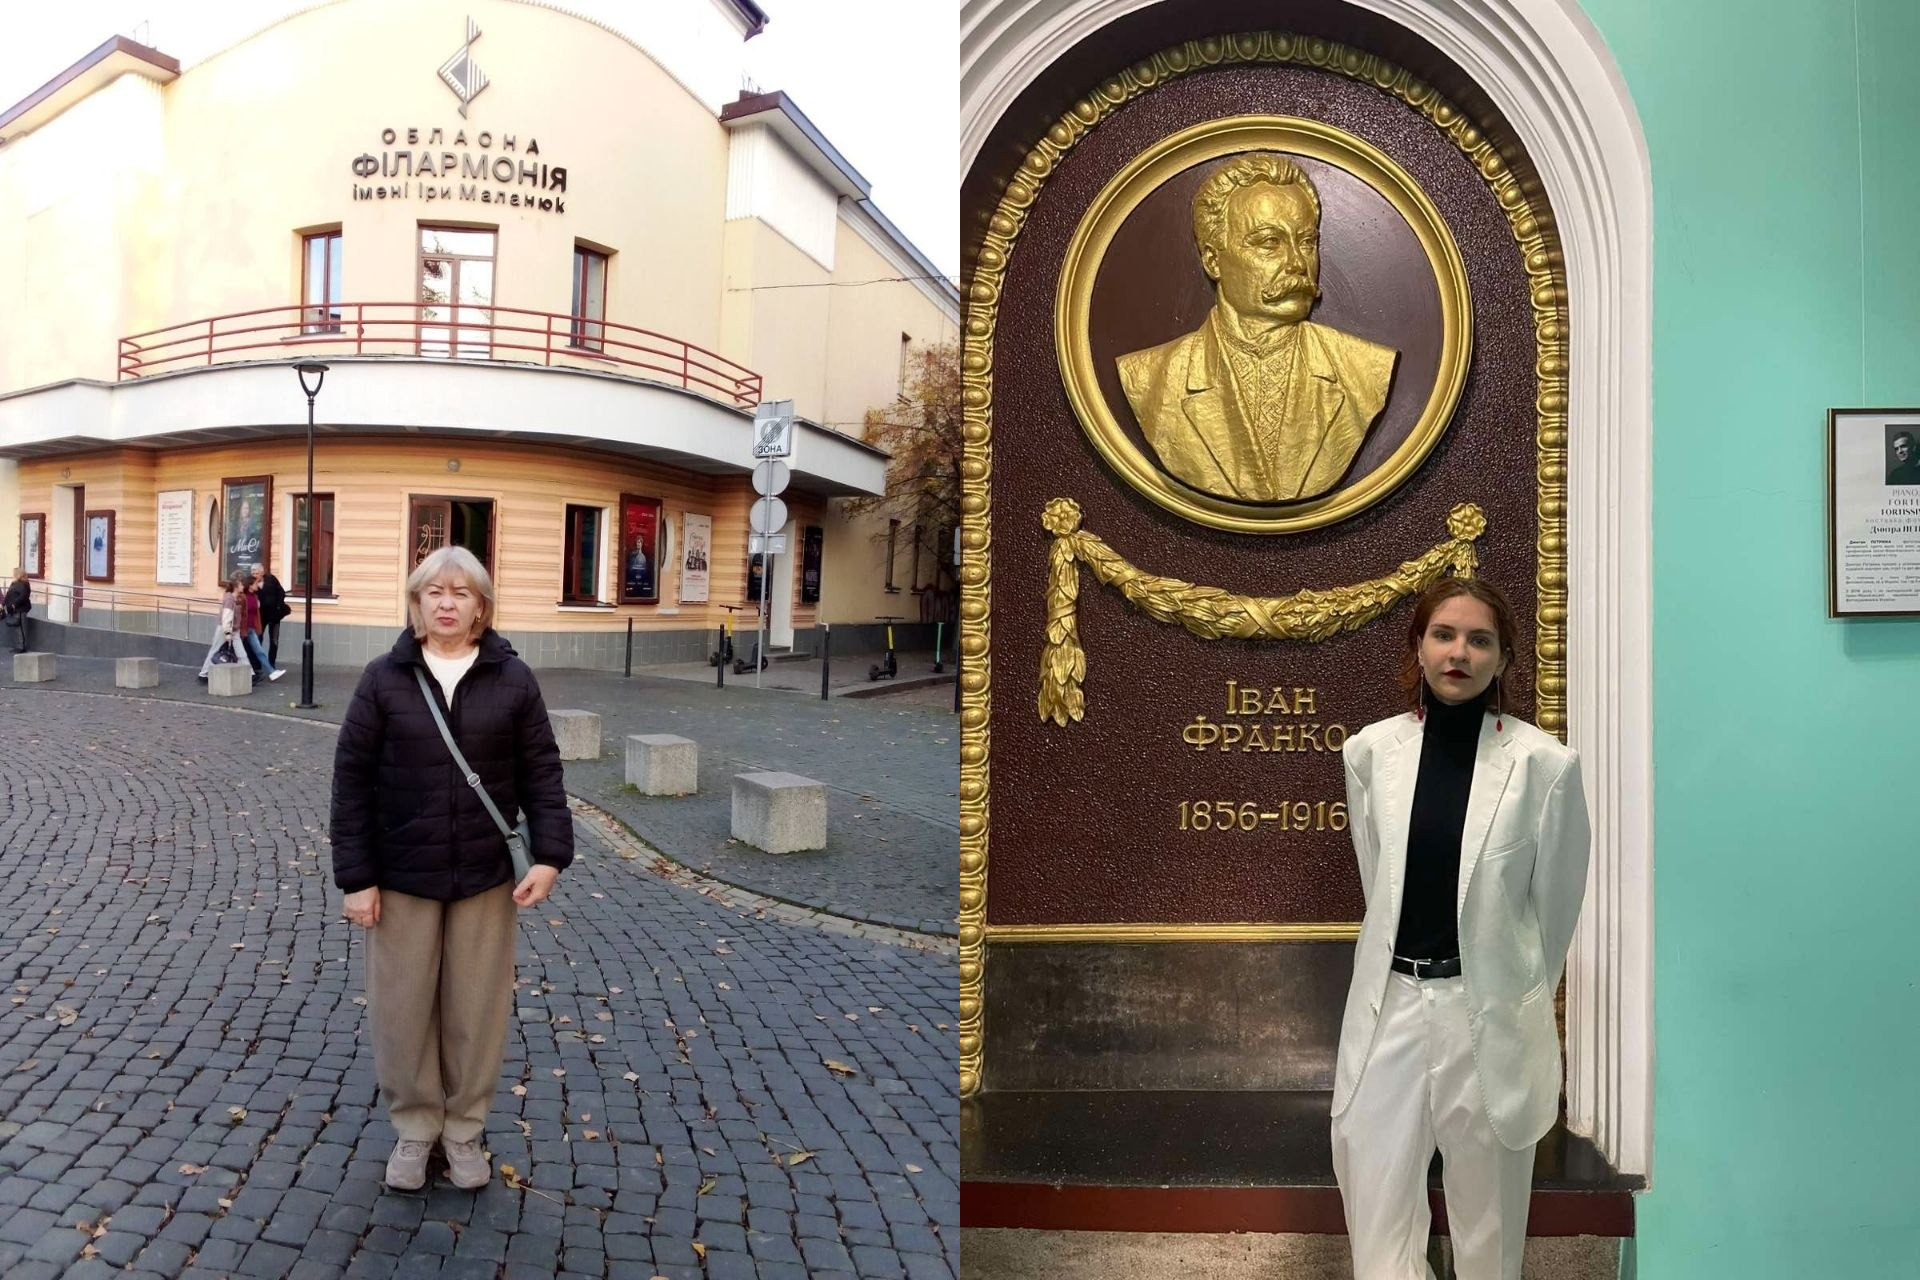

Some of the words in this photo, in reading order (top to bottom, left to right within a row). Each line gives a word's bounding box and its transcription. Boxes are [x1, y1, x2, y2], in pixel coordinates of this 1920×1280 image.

[381, 127, 540, 155] ОБЛАСНА
[351, 150, 568, 193] ФІЛАРМОНІЯ
[353, 181, 409, 201] імені
[418, 181, 451, 203] Іри
[758, 445, 783, 454] ЗОНА
[1881, 508, 1920, 516] FORTISSI
